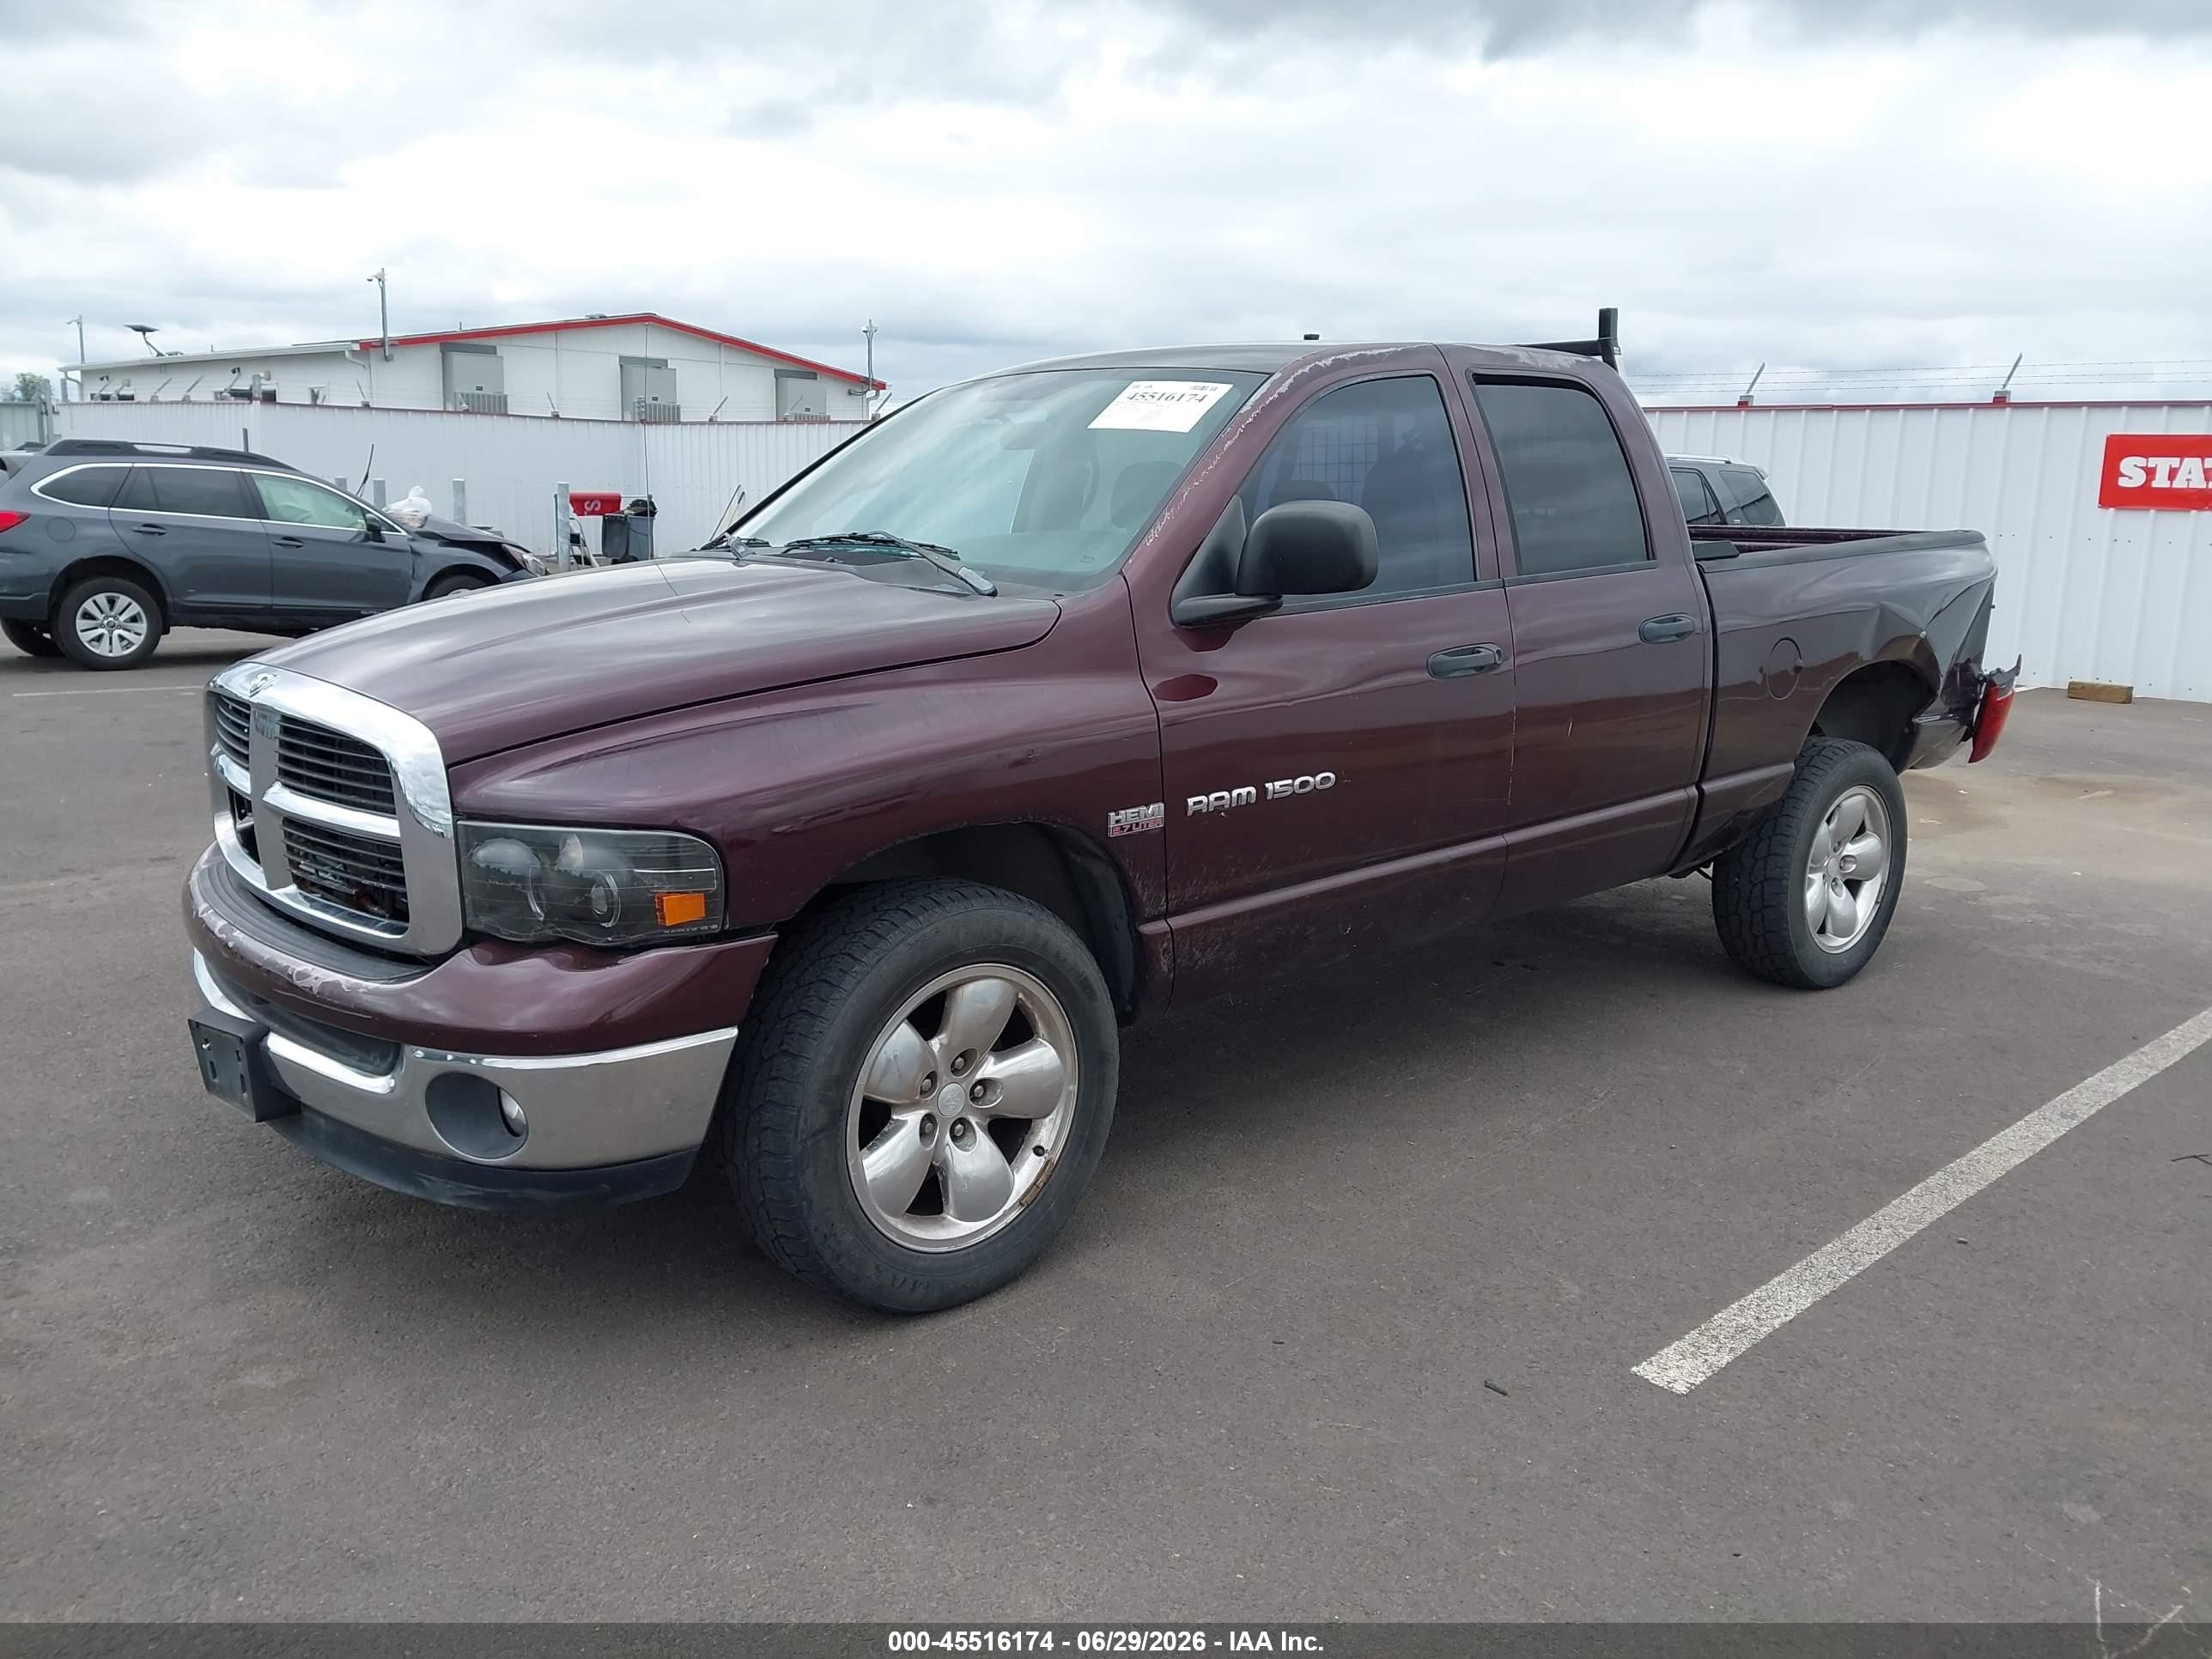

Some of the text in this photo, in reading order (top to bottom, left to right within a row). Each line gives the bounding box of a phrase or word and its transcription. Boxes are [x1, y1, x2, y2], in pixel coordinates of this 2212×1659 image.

[1126, 392, 1208, 403] 45516174
[2117, 456, 2212, 489] STA
[1187, 772, 1336, 817] RAM 1500
[1108, 801, 1164, 825] HEMI
[1112, 824, 1131, 836] 5.7
